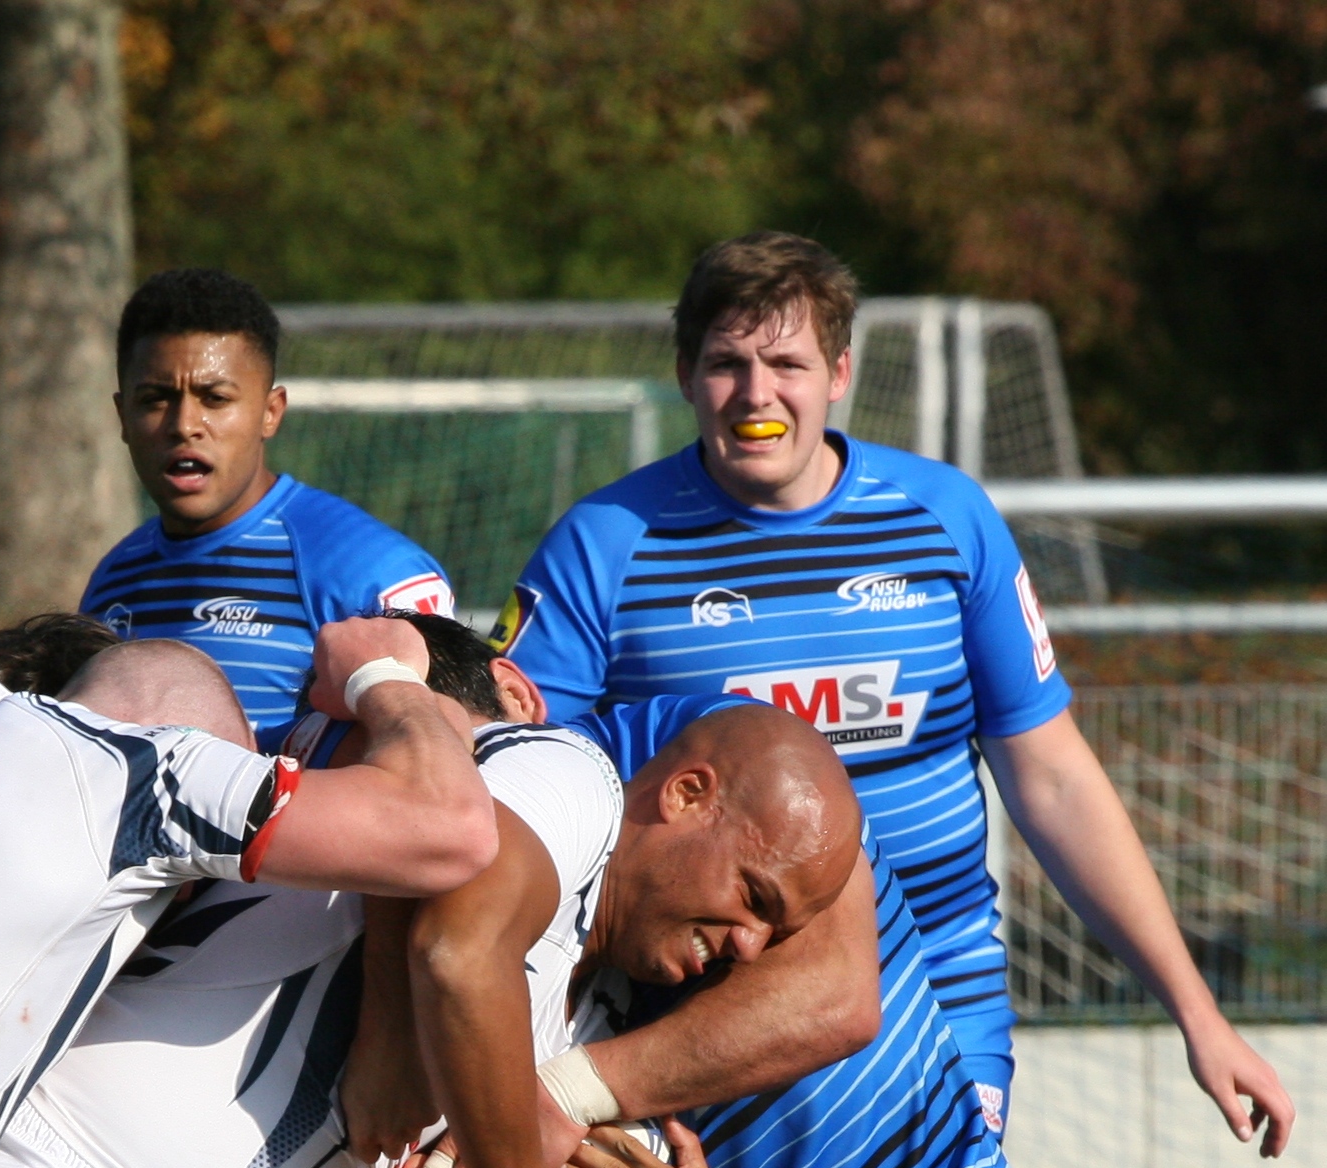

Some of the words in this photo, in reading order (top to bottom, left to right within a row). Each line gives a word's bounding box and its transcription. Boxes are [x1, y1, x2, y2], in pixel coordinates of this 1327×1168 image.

[872, 579, 907, 596] NSU
[870, 593, 927, 612] RUGBY
[219, 605, 259, 621] NSU
[213, 620, 273, 637] RUGBY
[730, 672, 903, 724] MS.
